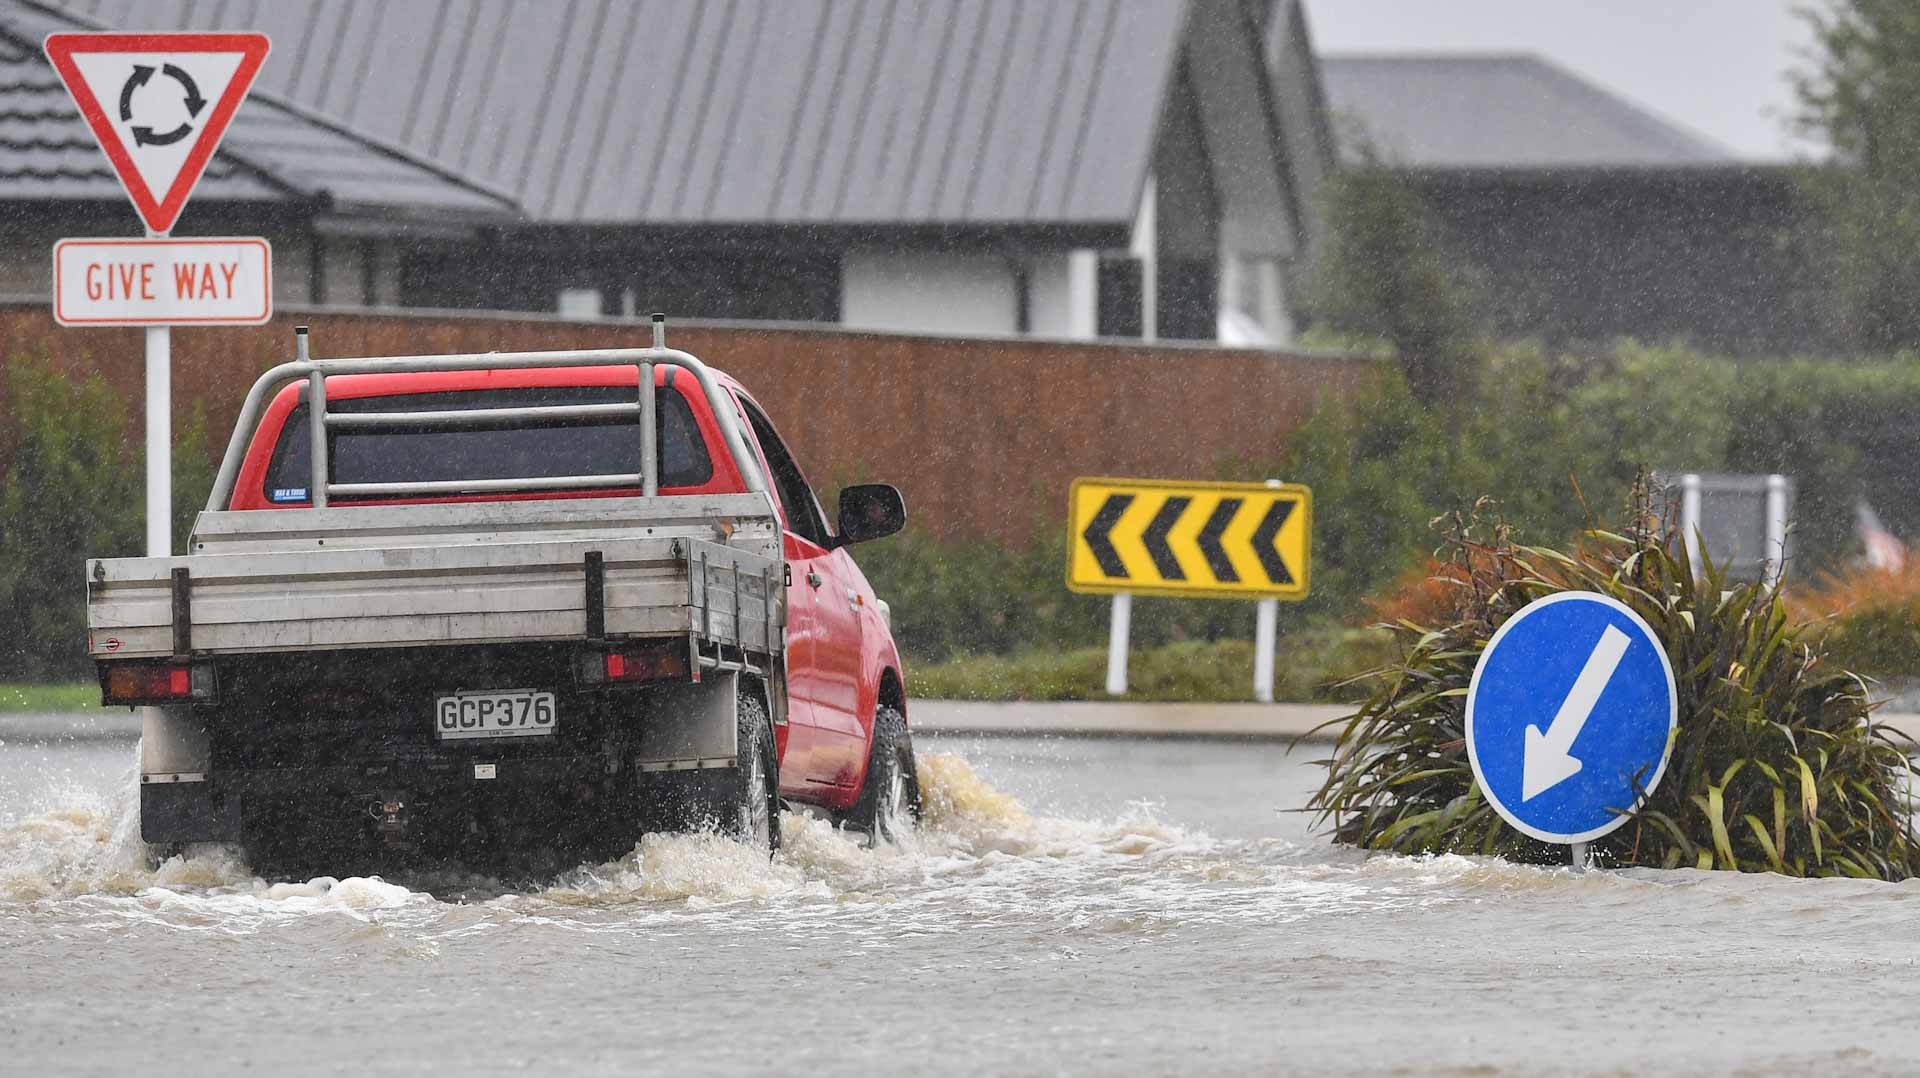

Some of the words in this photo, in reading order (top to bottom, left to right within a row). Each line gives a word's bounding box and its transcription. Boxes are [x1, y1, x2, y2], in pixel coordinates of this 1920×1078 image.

[86, 263, 156, 301] GIVE
[174, 262, 239, 300] WAY
[440, 696, 552, 729] GCP376
